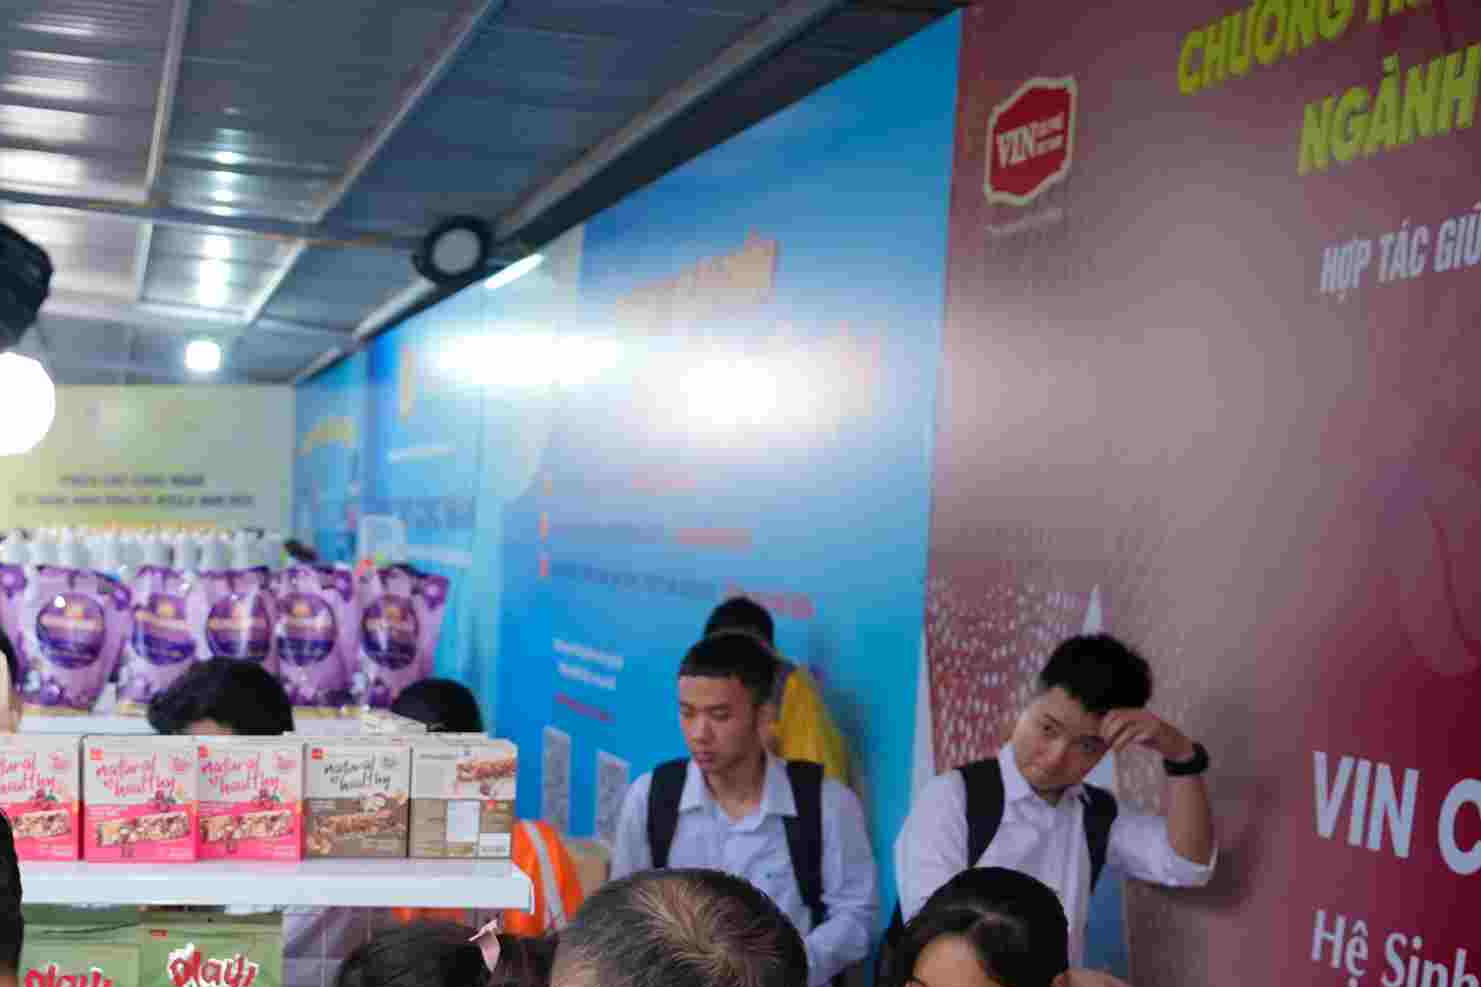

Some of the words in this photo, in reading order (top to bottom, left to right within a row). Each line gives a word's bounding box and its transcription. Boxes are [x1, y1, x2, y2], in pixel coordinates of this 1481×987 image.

[995, 125, 1033, 168] VIN
[1378, 215, 1429, 282] TÁC
[1312, 750, 1420, 859] VIN
